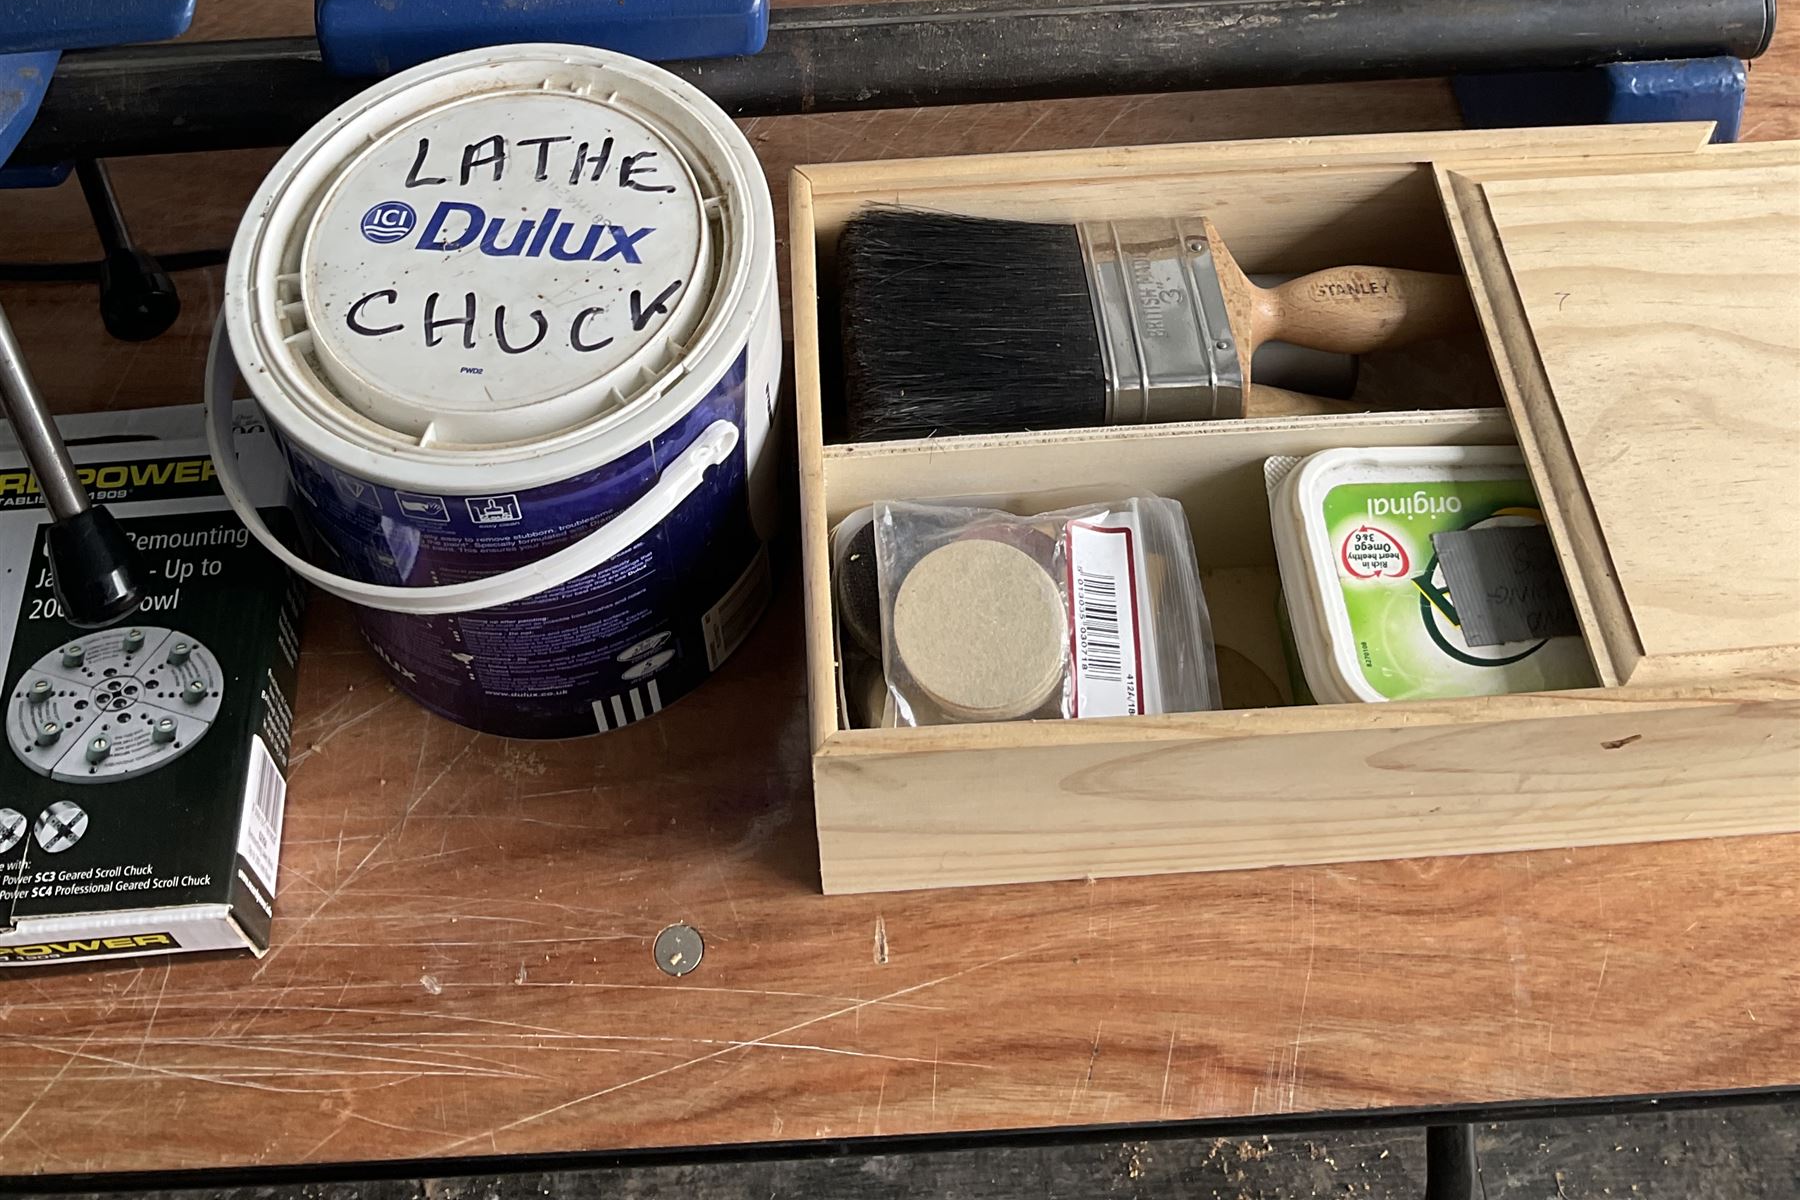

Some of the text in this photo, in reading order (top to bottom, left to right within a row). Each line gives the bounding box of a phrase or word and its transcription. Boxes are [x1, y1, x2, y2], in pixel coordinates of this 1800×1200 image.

[405, 135, 677, 193] LATHE
[372, 208, 407, 227] ICI
[415, 201, 657, 264] Dulux
[1316, 281, 1390, 298] STANLEY
[346, 280, 683, 354] CHUCK
[1367, 491, 1462, 520] original
[1348, 552, 1377, 561] healthy
[1354, 541, 1391, 552] Omega
[165, 559, 194, 583] Up
[201, 559, 222, 576] to
[1362, 561, 1370, 569] in
[140, 589, 180, 611] owl
[1080, 627, 1088, 670] 030718
[2, 864, 153, 886] Power SC3 Geared Scroll Chuck
[31, 886, 53, 898] SC4
[55, 882, 113, 896] Professional
[115, 879, 150, 892] Geared
[153, 877, 179, 889] Scroll
[181, 874, 211, 886] Chuck
